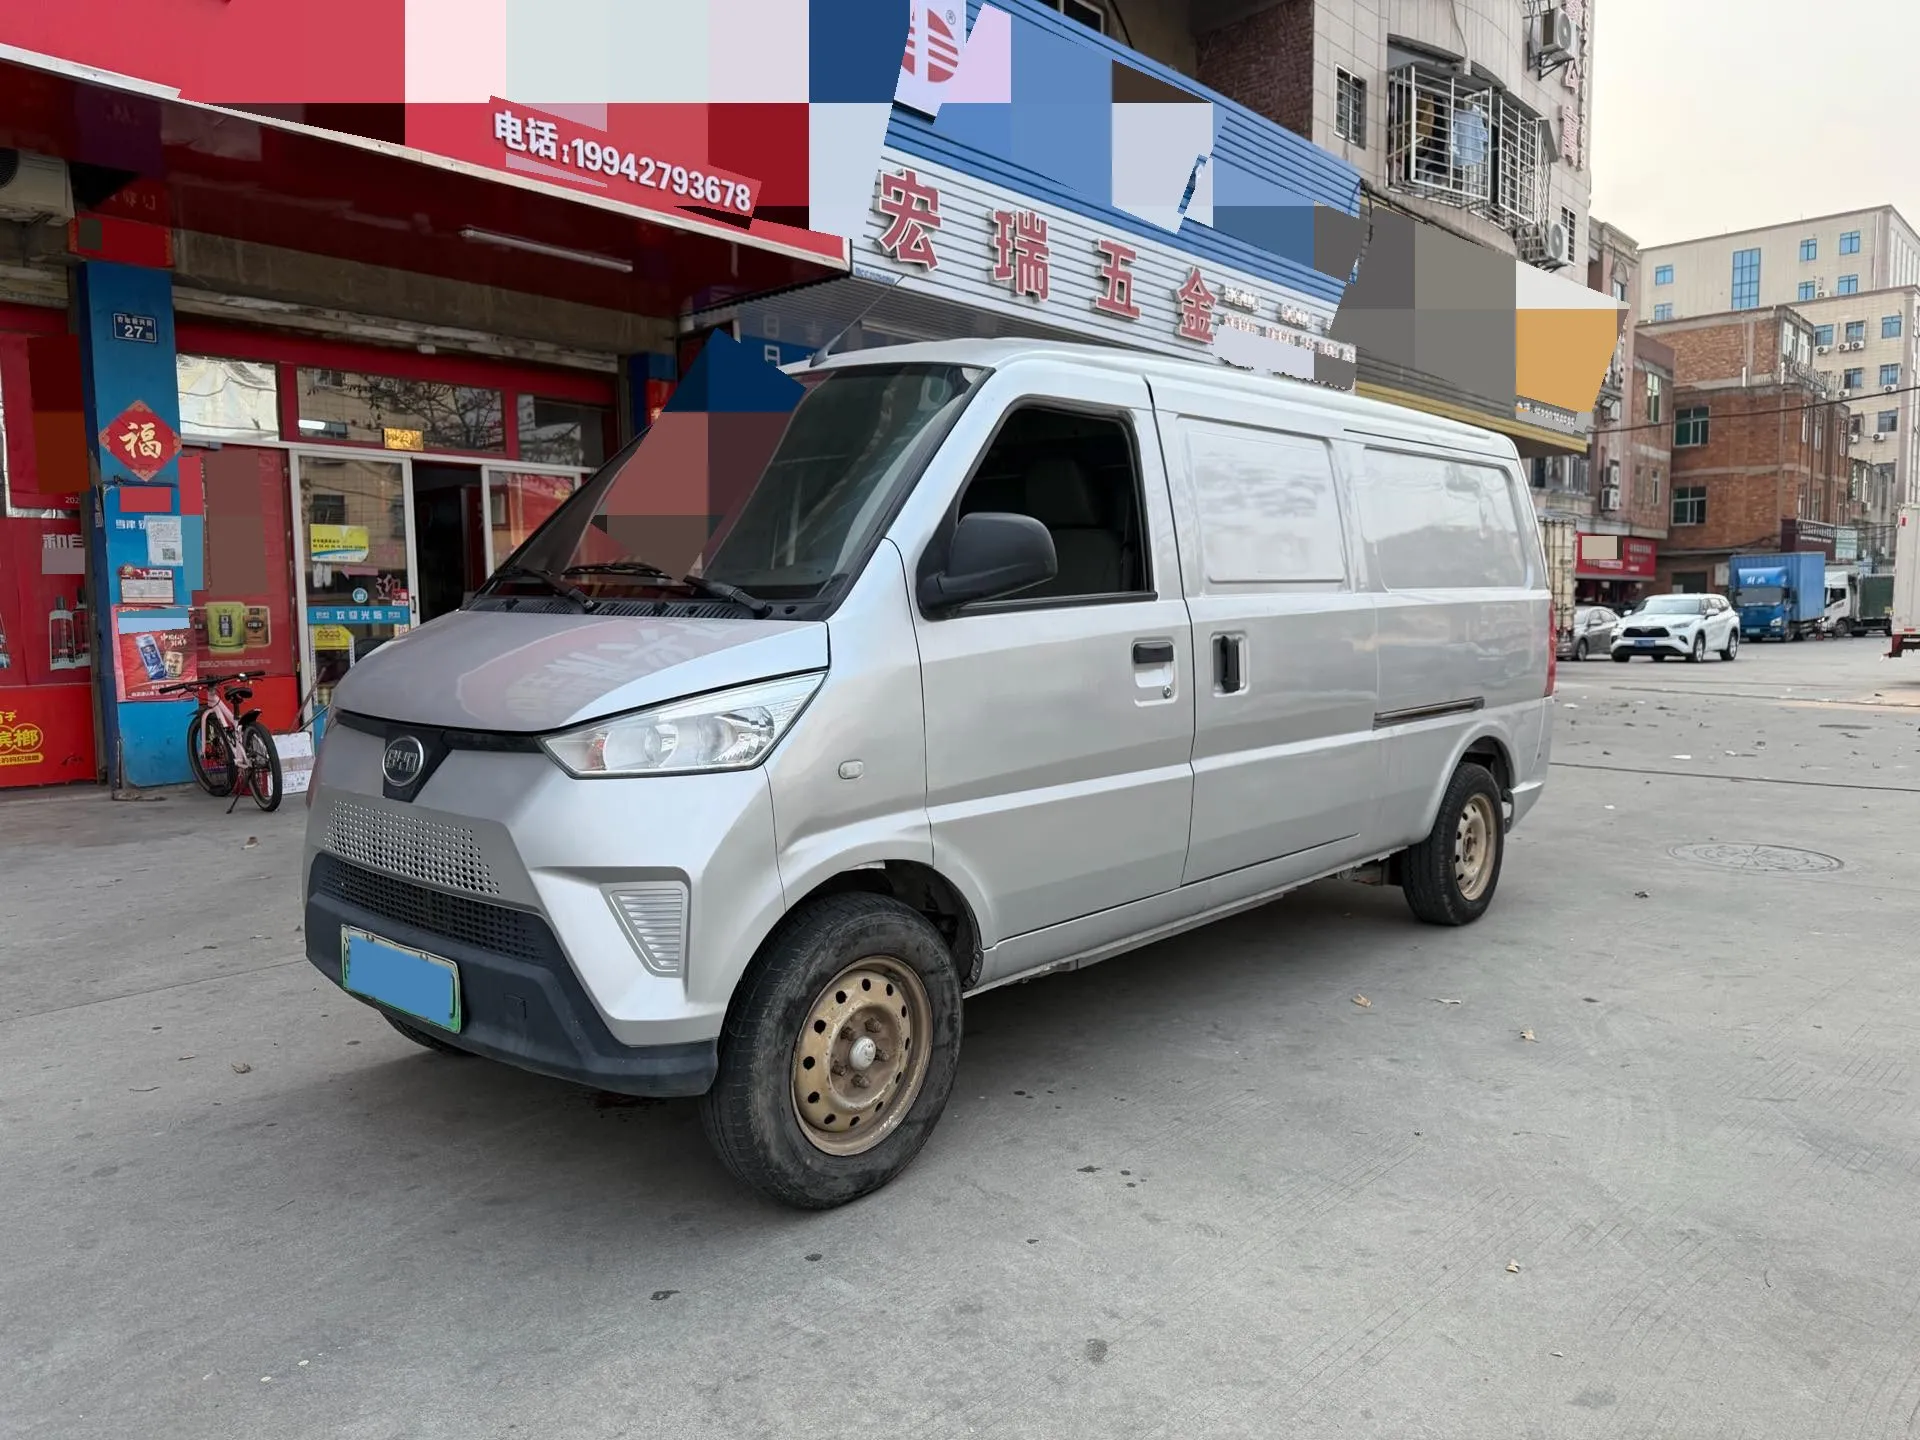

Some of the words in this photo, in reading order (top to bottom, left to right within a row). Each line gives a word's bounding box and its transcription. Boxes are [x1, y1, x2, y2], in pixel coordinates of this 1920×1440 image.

[878, 168, 1217, 345] 宏瑞五金
[124, 324, 143, 339] 27
[119, 422, 162, 459] 福
